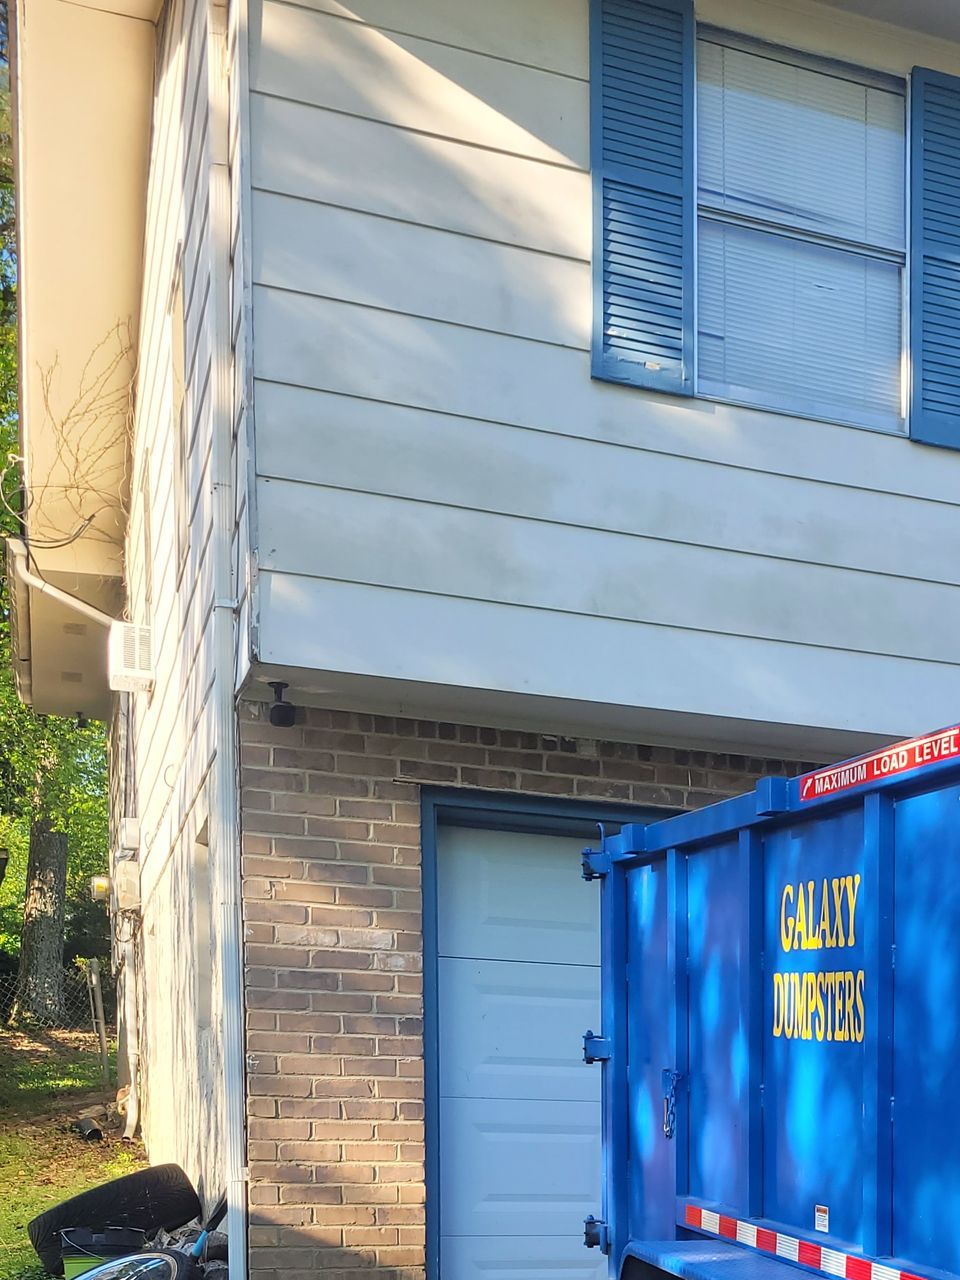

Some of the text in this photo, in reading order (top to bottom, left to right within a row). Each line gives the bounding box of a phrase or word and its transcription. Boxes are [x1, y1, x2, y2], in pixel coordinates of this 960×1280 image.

[815, 735, 959, 794] MAXIMUM LOAD LEVEL
[780, 874, 861, 952] GALAXY
[773, 970, 865, 1043] DUMPSTERS
